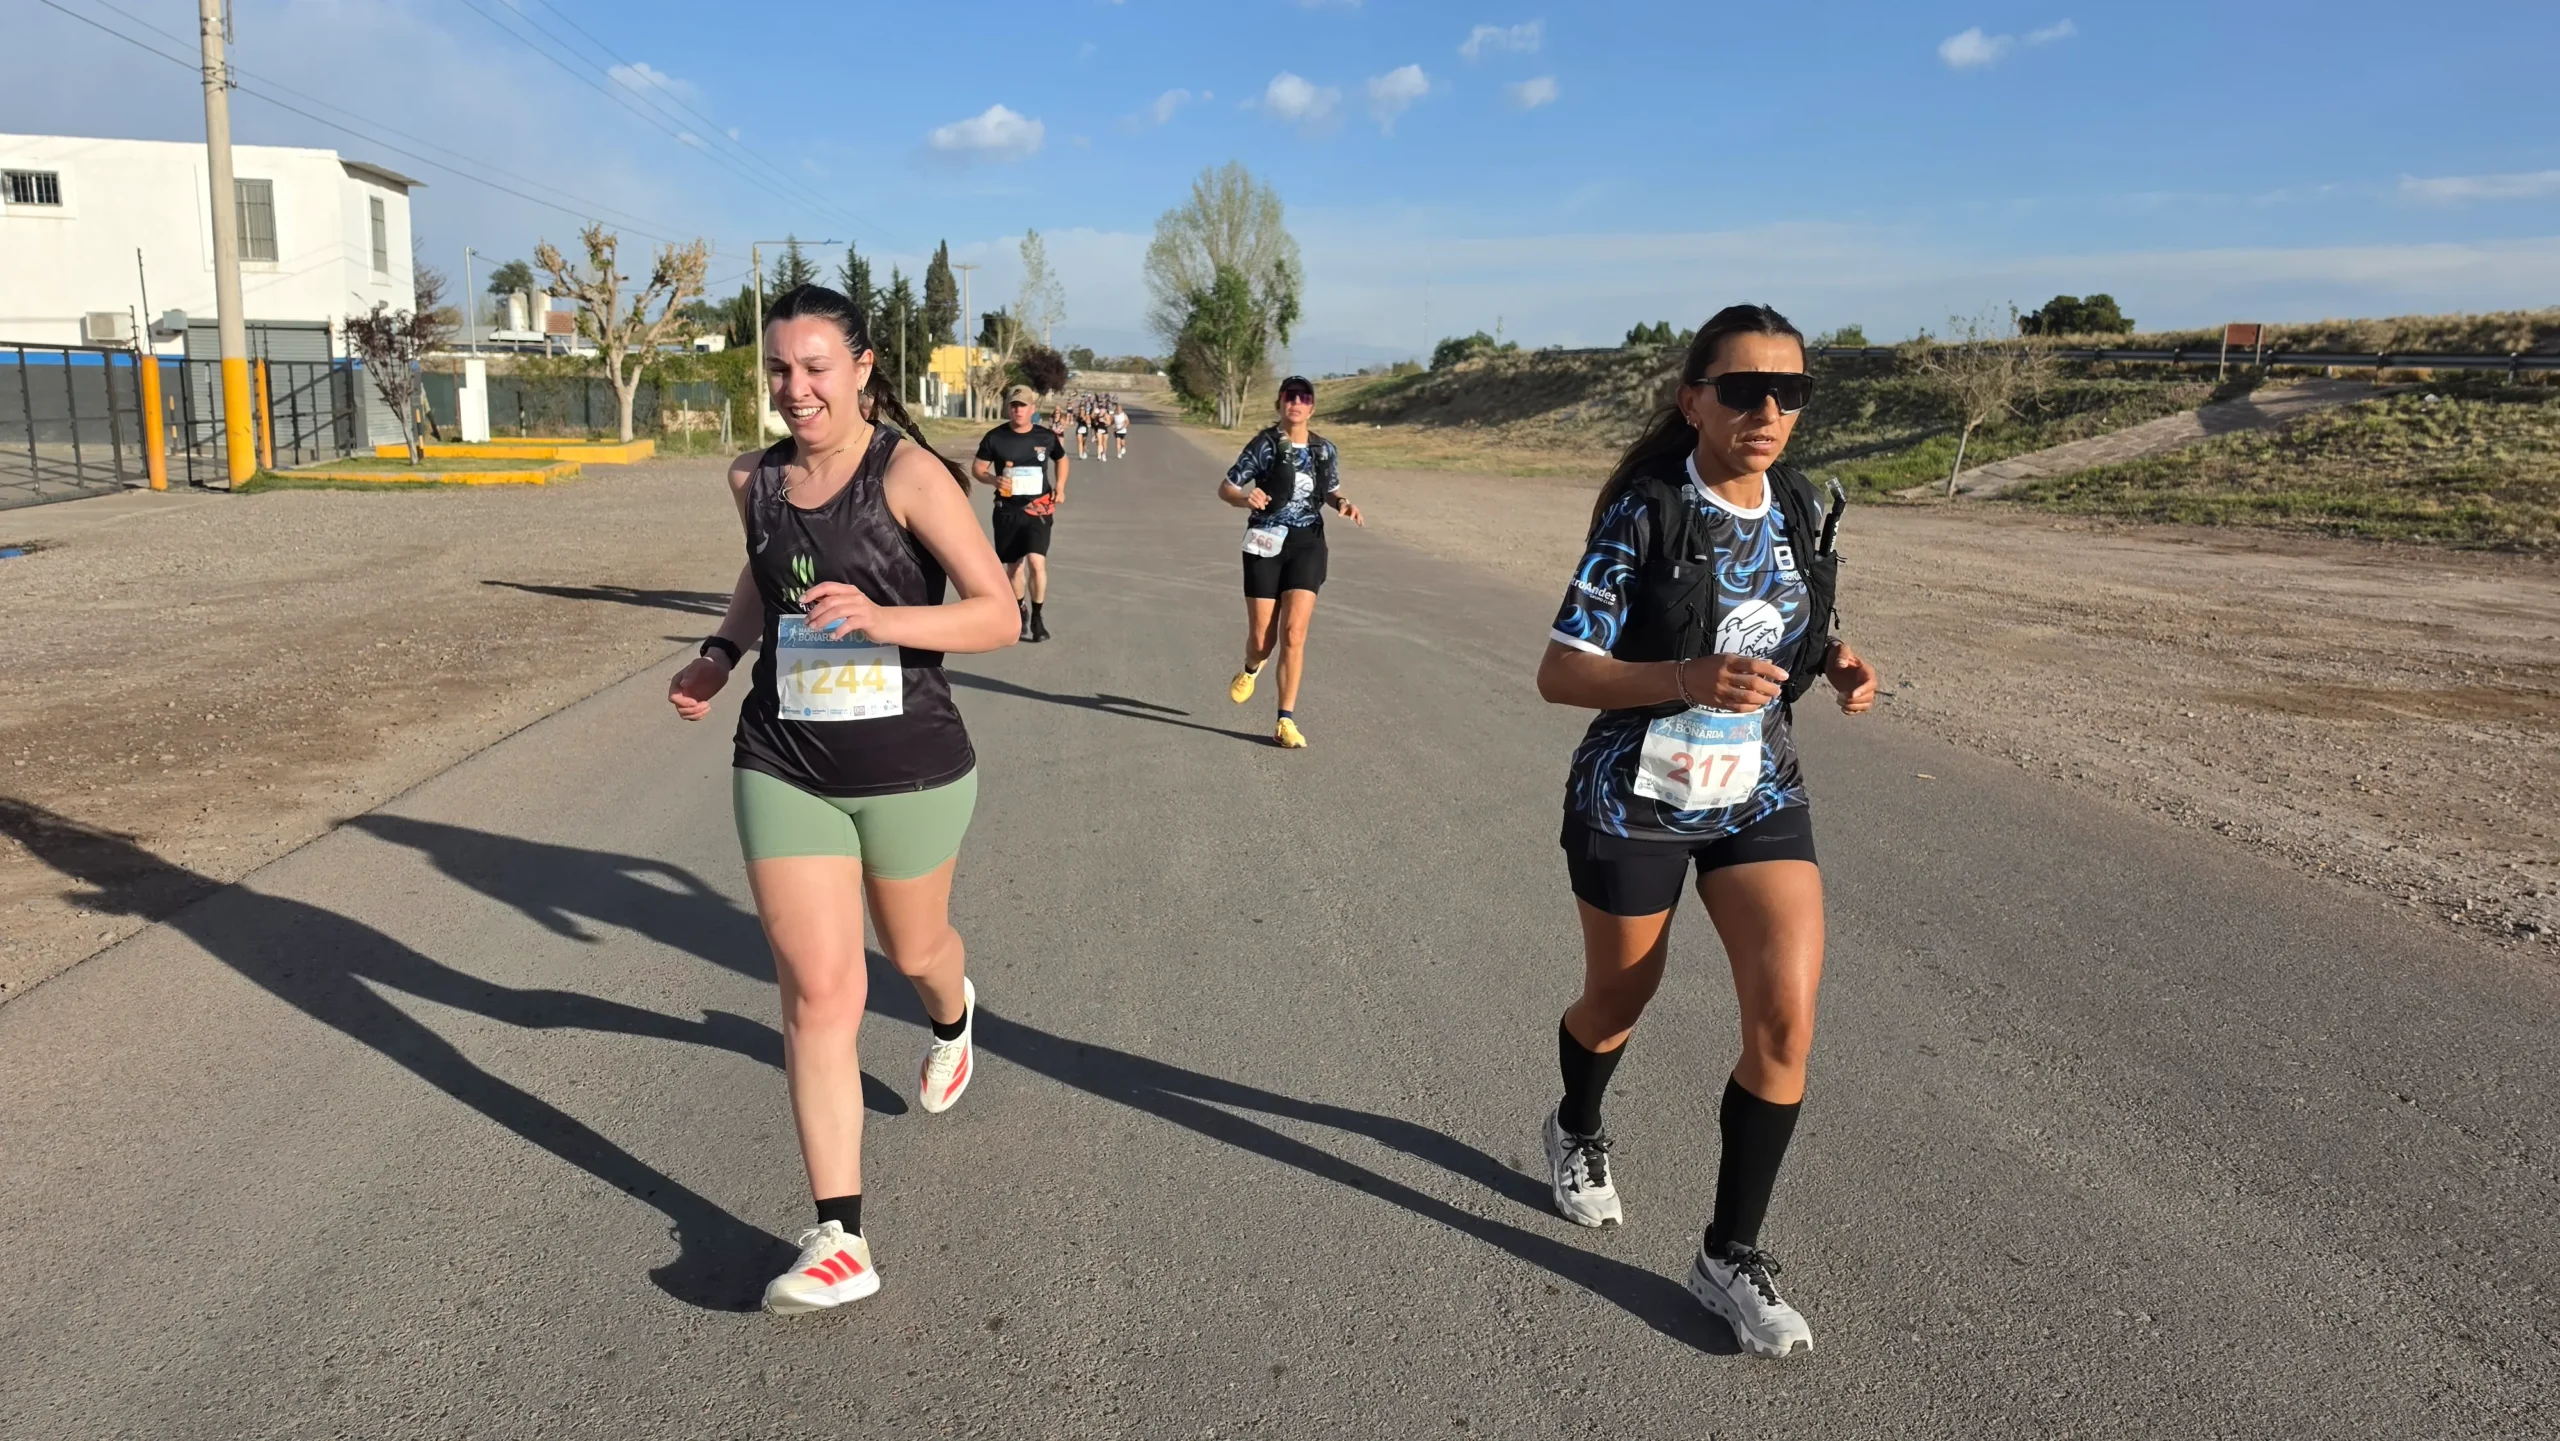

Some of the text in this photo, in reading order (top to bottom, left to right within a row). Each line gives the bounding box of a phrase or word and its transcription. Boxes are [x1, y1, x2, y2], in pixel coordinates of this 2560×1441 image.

[1773, 545, 1795, 571] B
[1781, 568, 1809, 581] BONA
[789, 657, 887, 695] 1244
[1675, 723, 1724, 739] BONARDA
[1666, 751, 1740, 788] 217
